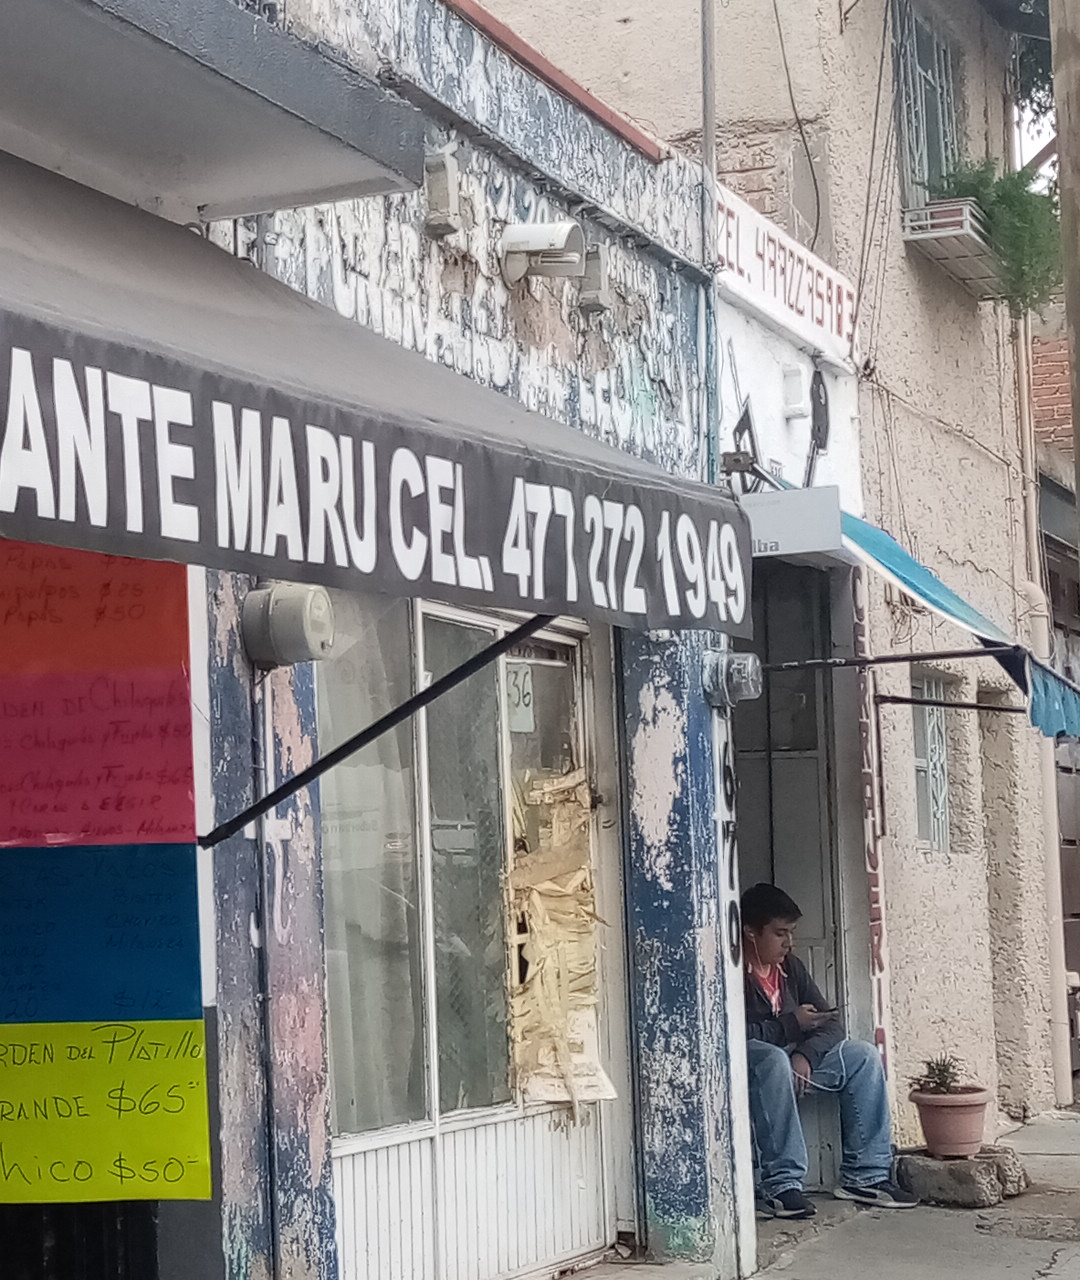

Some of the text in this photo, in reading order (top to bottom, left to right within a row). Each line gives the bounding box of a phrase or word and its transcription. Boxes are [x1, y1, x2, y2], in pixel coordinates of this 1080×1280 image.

[211, 400, 377, 574] MARU
[389, 447, 494, 592] CEL.
[501, 476, 578, 602] 477
[584, 495, 648, 615] 272
[655, 510, 745, 623] 1949
